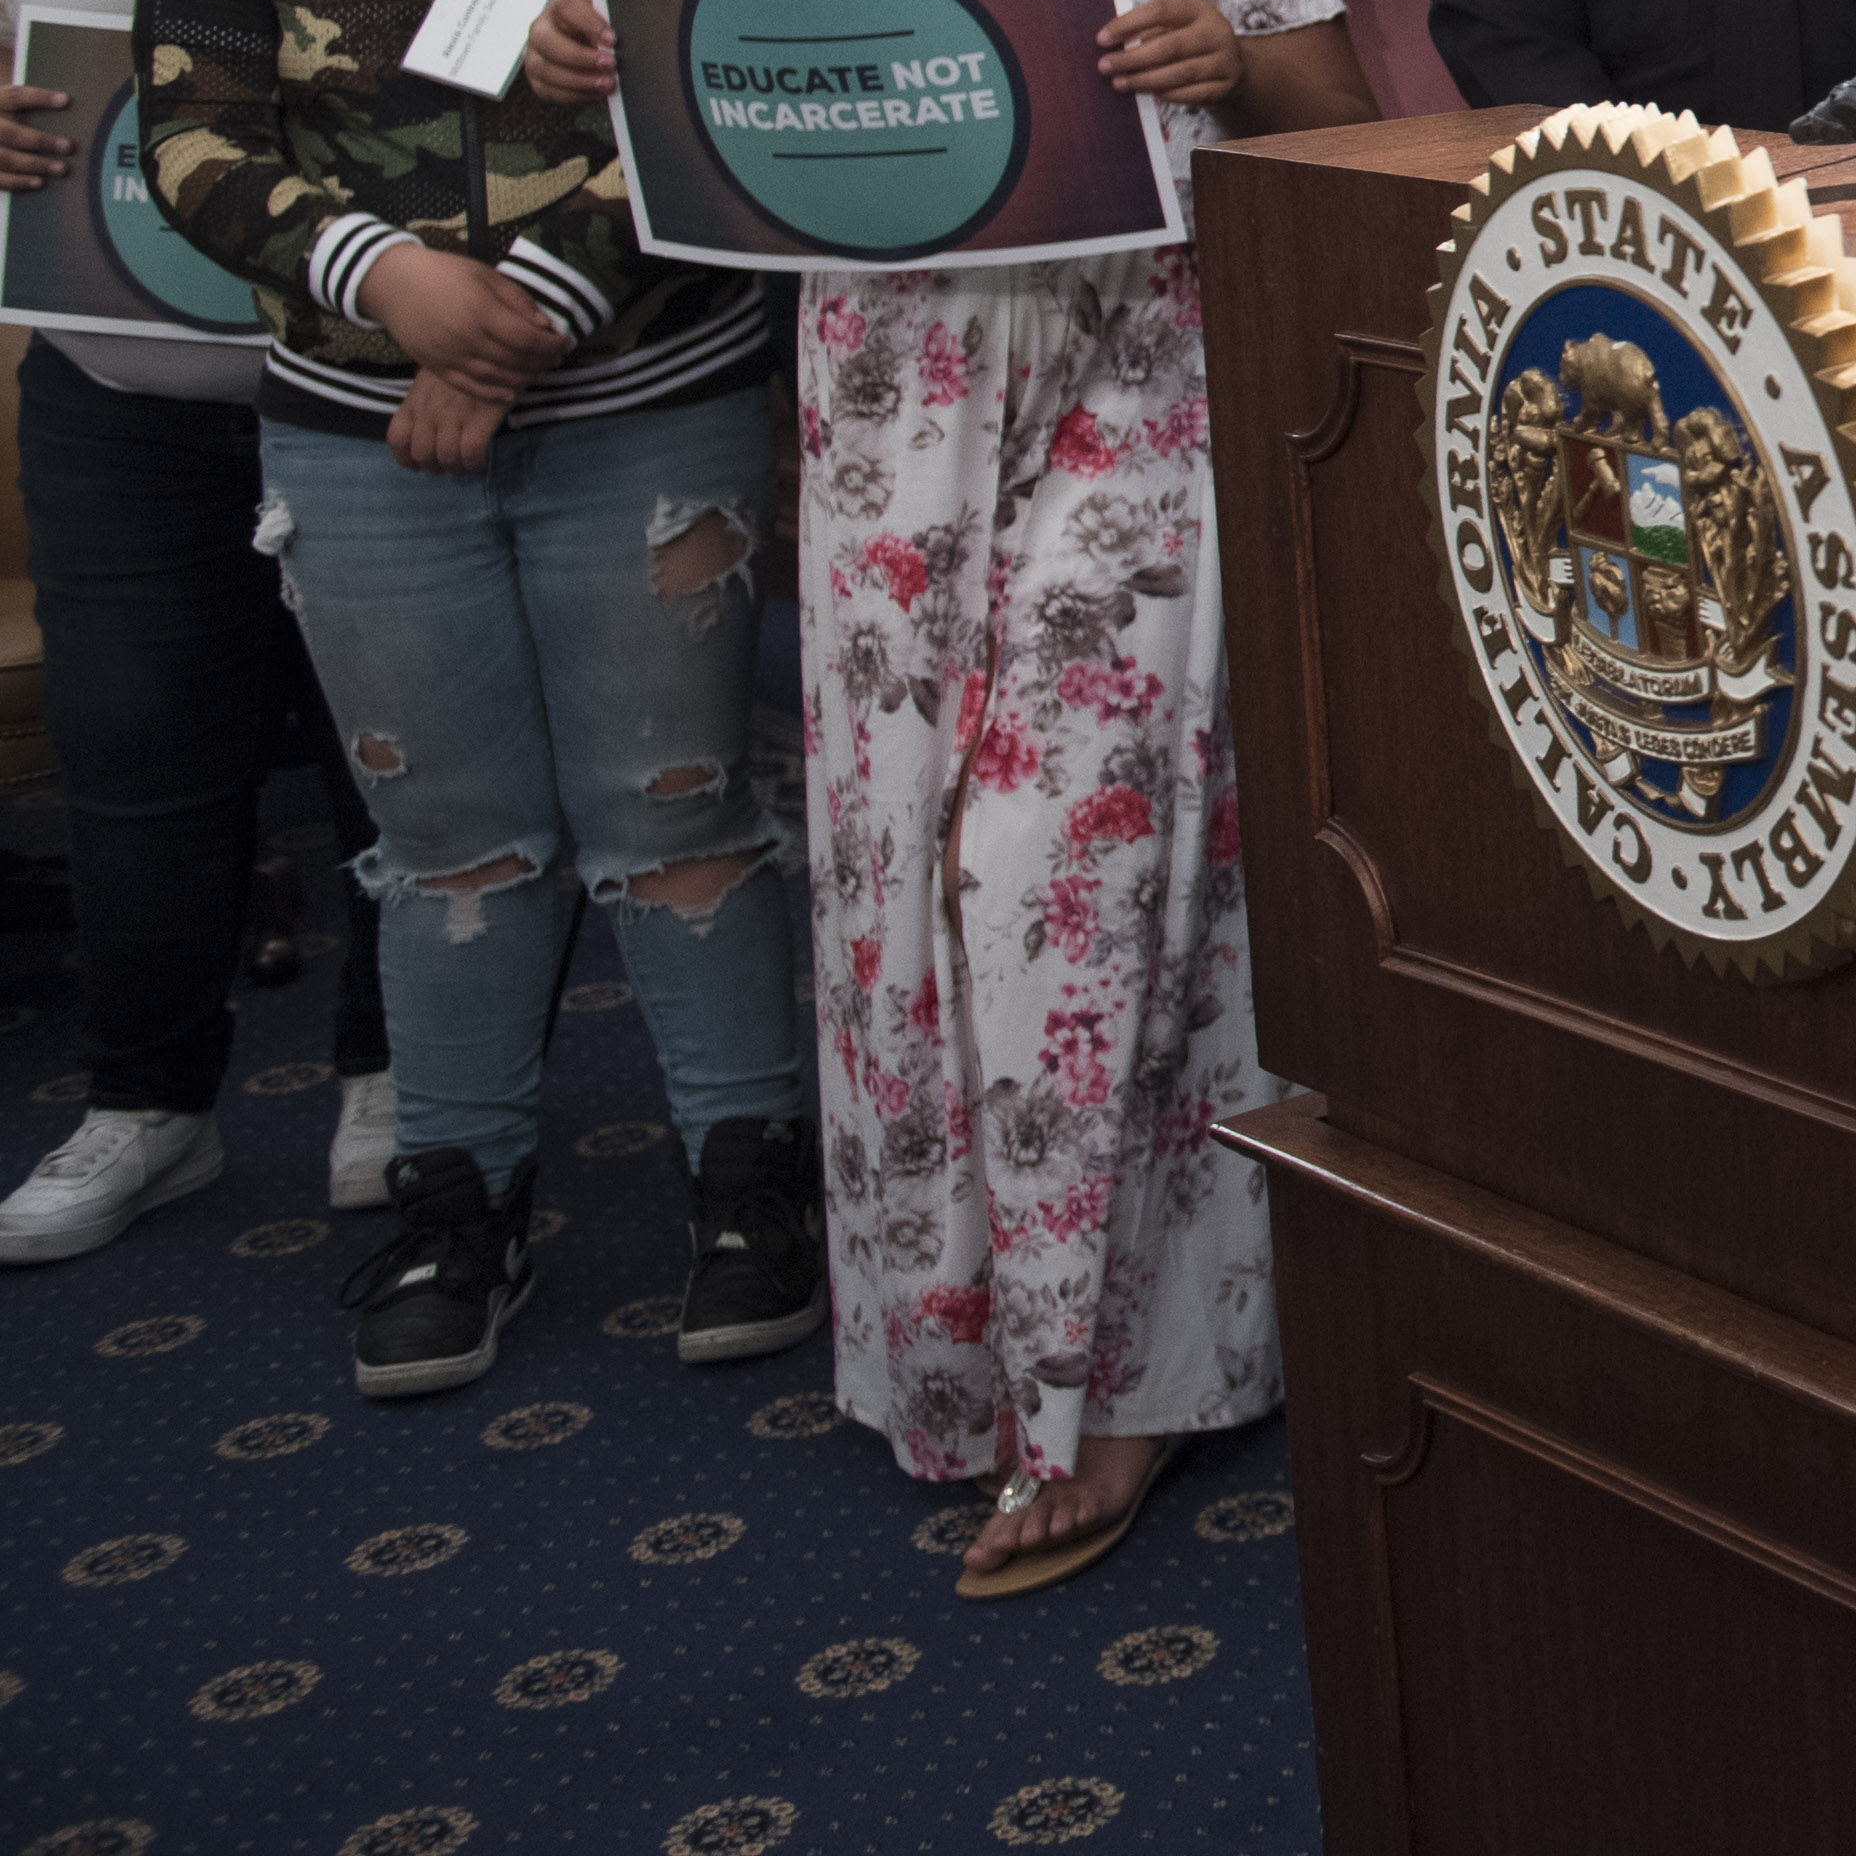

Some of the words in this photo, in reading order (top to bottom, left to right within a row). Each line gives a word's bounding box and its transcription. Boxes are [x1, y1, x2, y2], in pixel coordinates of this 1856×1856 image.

[701, 59, 883, 94] EDUCATE
[891, 51, 986, 90] NOT
[709, 89, 1000, 132] INCARCERATE
[1531, 187, 1753, 355] STATE
[1446, 271, 1652, 884] CALIFORNIA
